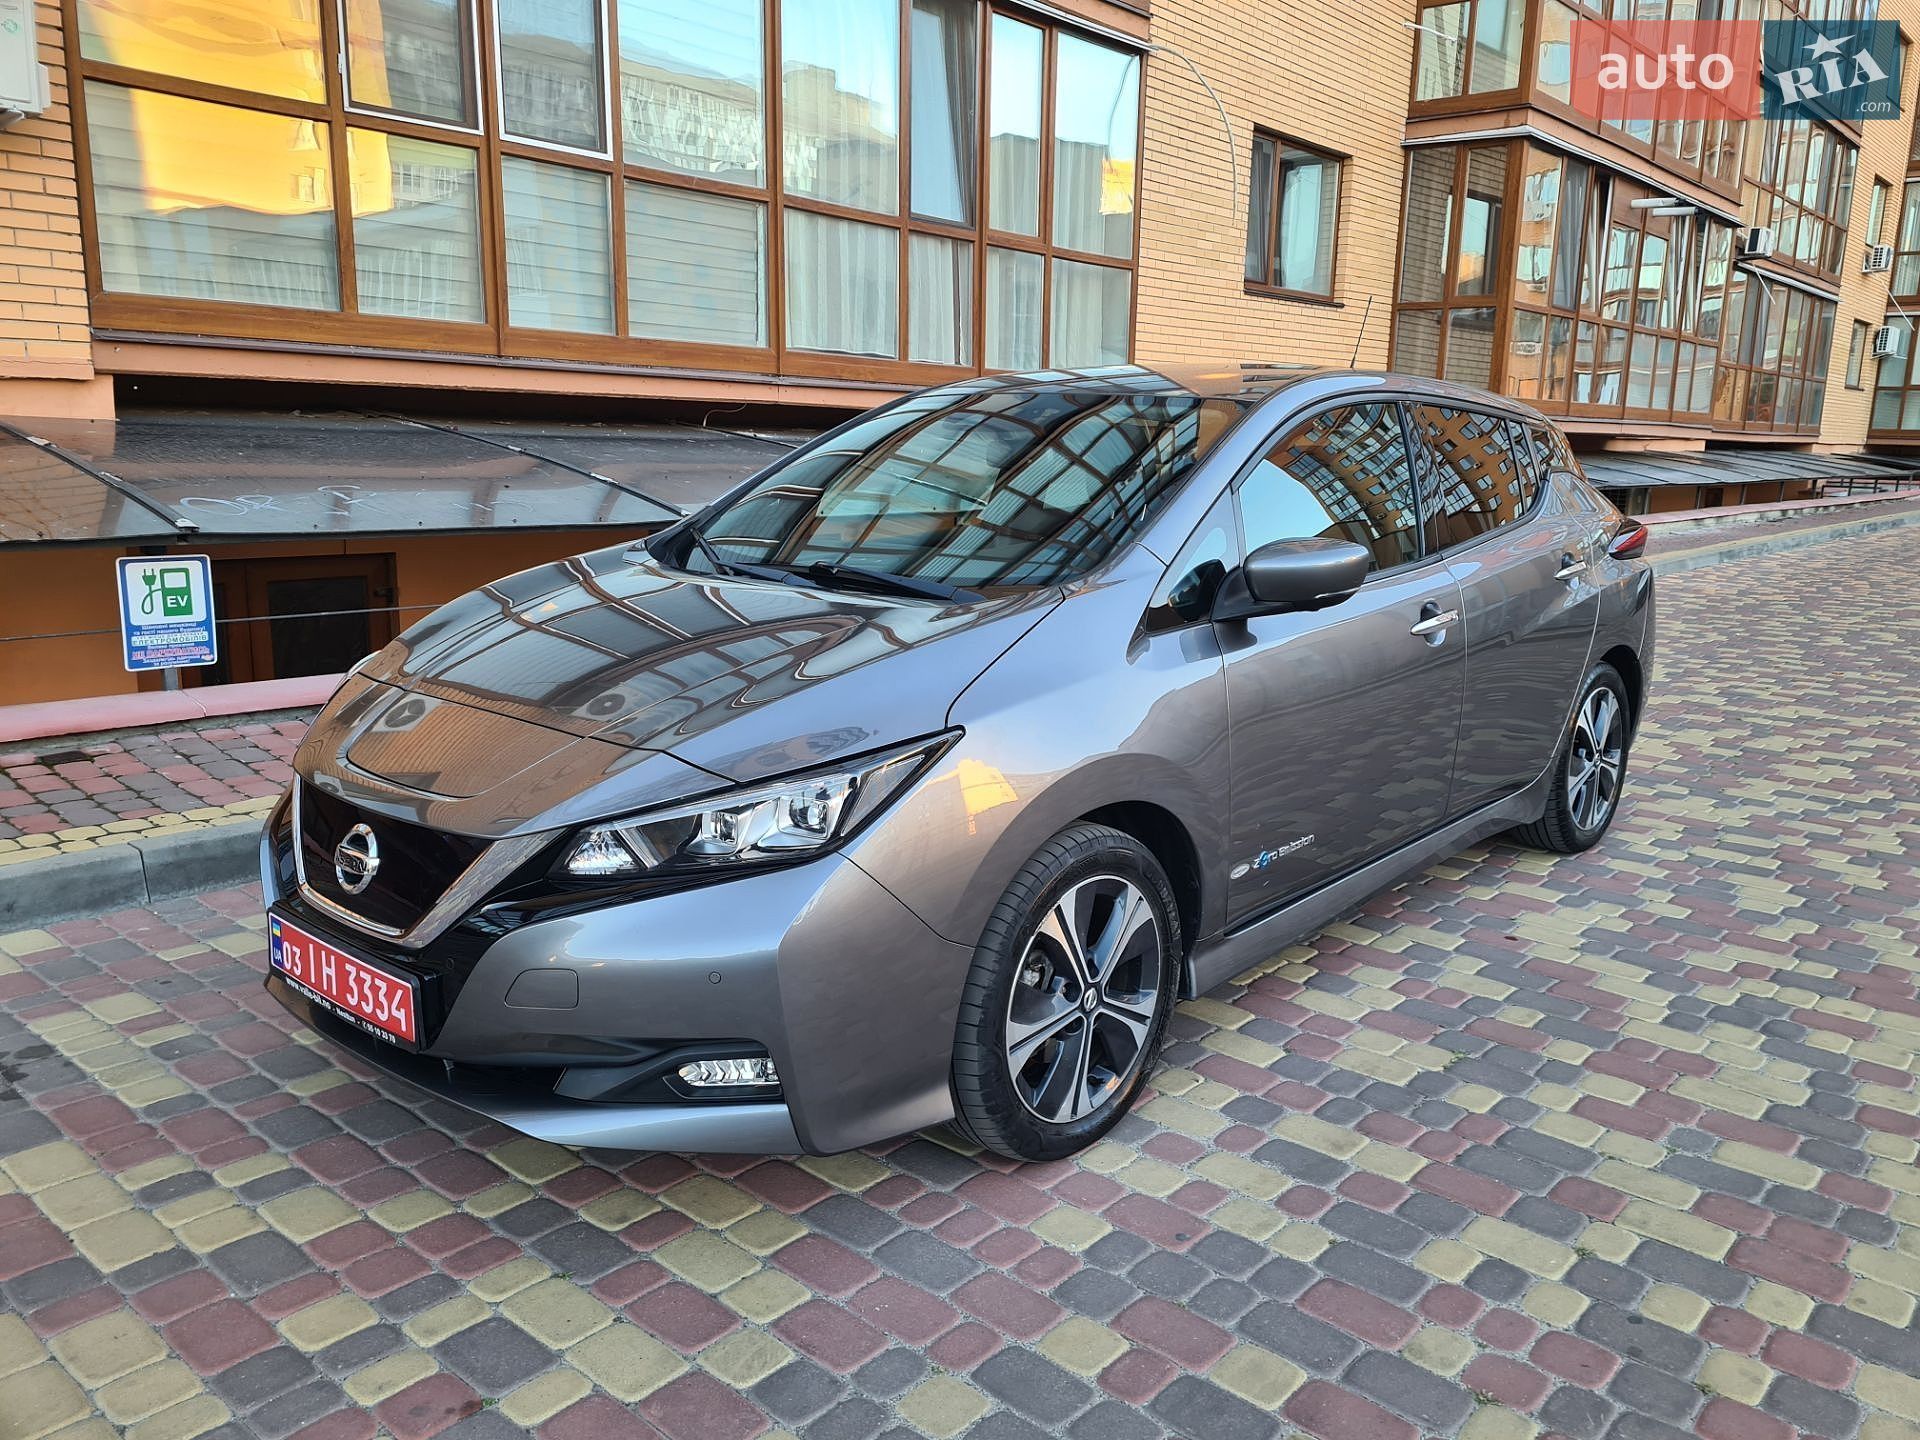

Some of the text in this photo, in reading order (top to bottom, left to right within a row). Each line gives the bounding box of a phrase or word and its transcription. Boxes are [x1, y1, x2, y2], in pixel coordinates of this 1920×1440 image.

[166, 595, 188, 608] EV
[273, 948, 283, 963] UA
[282, 941, 302, 976] 03
[345, 962, 407, 1032] 3334
